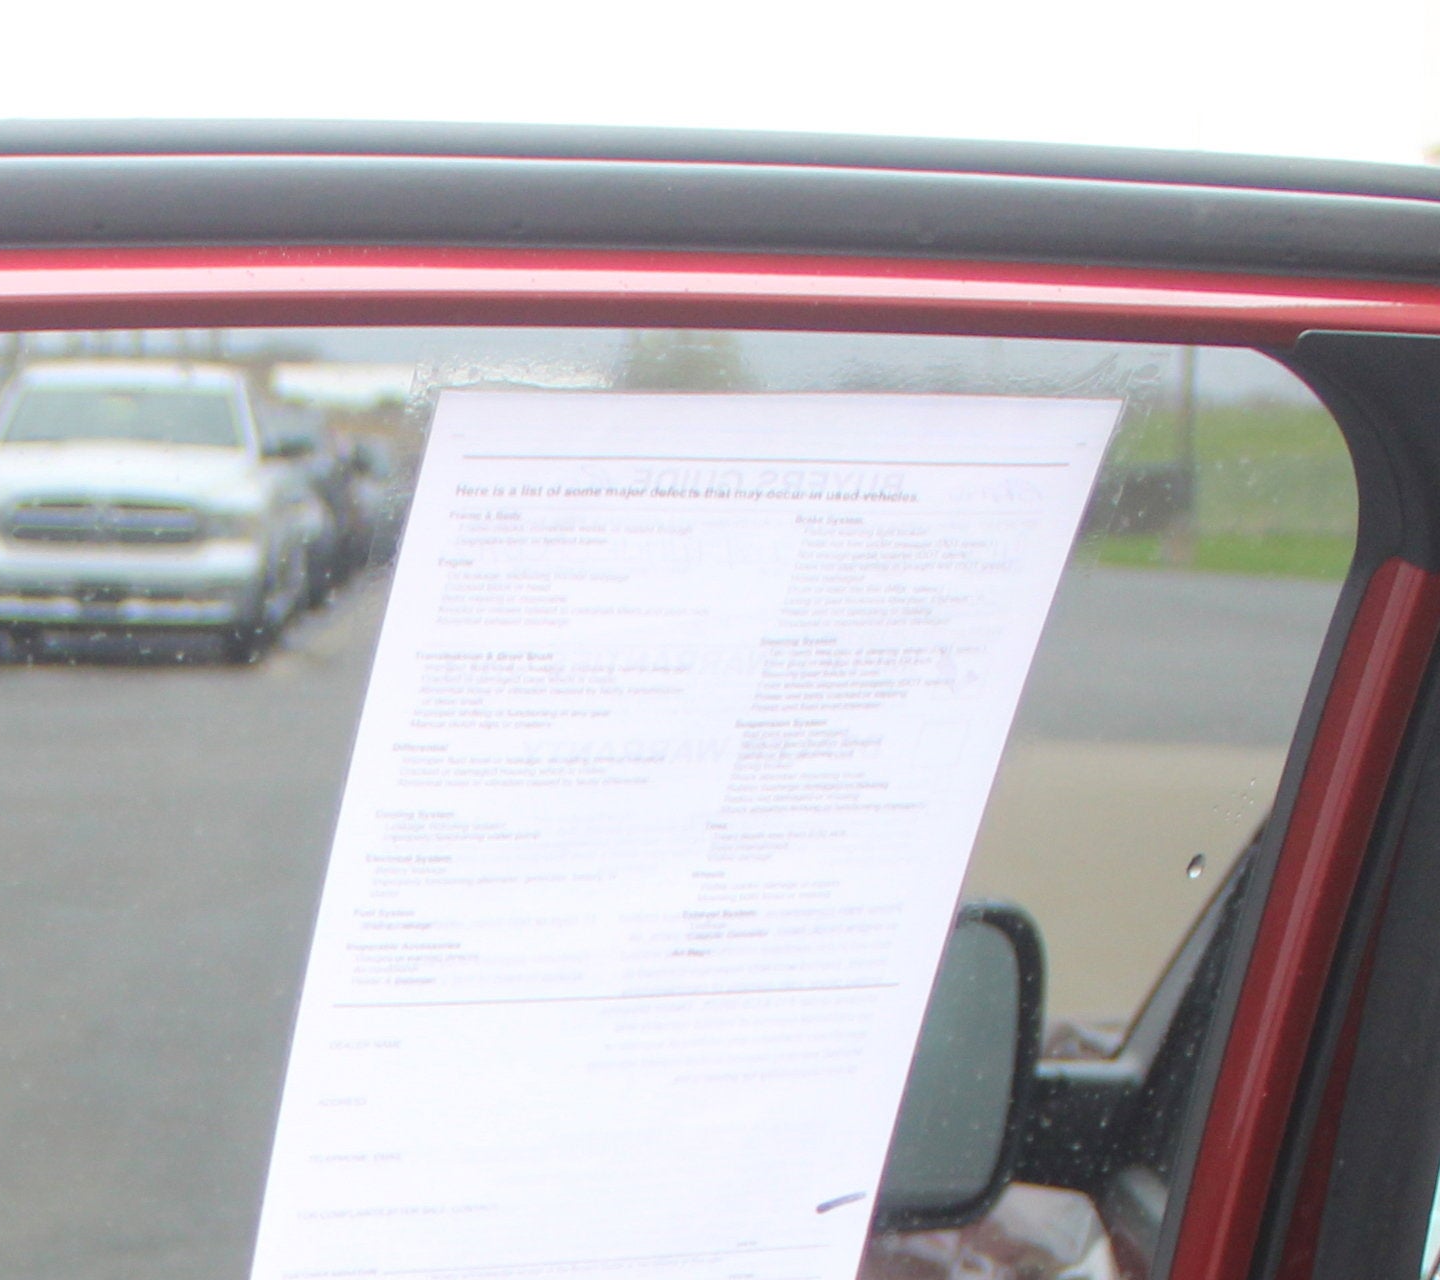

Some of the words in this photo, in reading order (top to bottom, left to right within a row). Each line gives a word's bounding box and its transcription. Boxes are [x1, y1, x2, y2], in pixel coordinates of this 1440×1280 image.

[456, 484, 488, 497] Here
[492, 485, 504, 497] is
[509, 487, 517, 497] a
[521, 485, 542, 497] list
[546, 485, 561, 497] of
[564, 487, 602, 498] some
[606, 486, 647, 500] major
[650, 486, 700, 499] defects
[704, 487, 730, 500] that
[734, 490, 762, 502] may
[767, 490, 806, 501] occur
[809, 489, 822, 501] in
[826, 489, 859, 502] used
[863, 489, 919, 503] vehicles.
